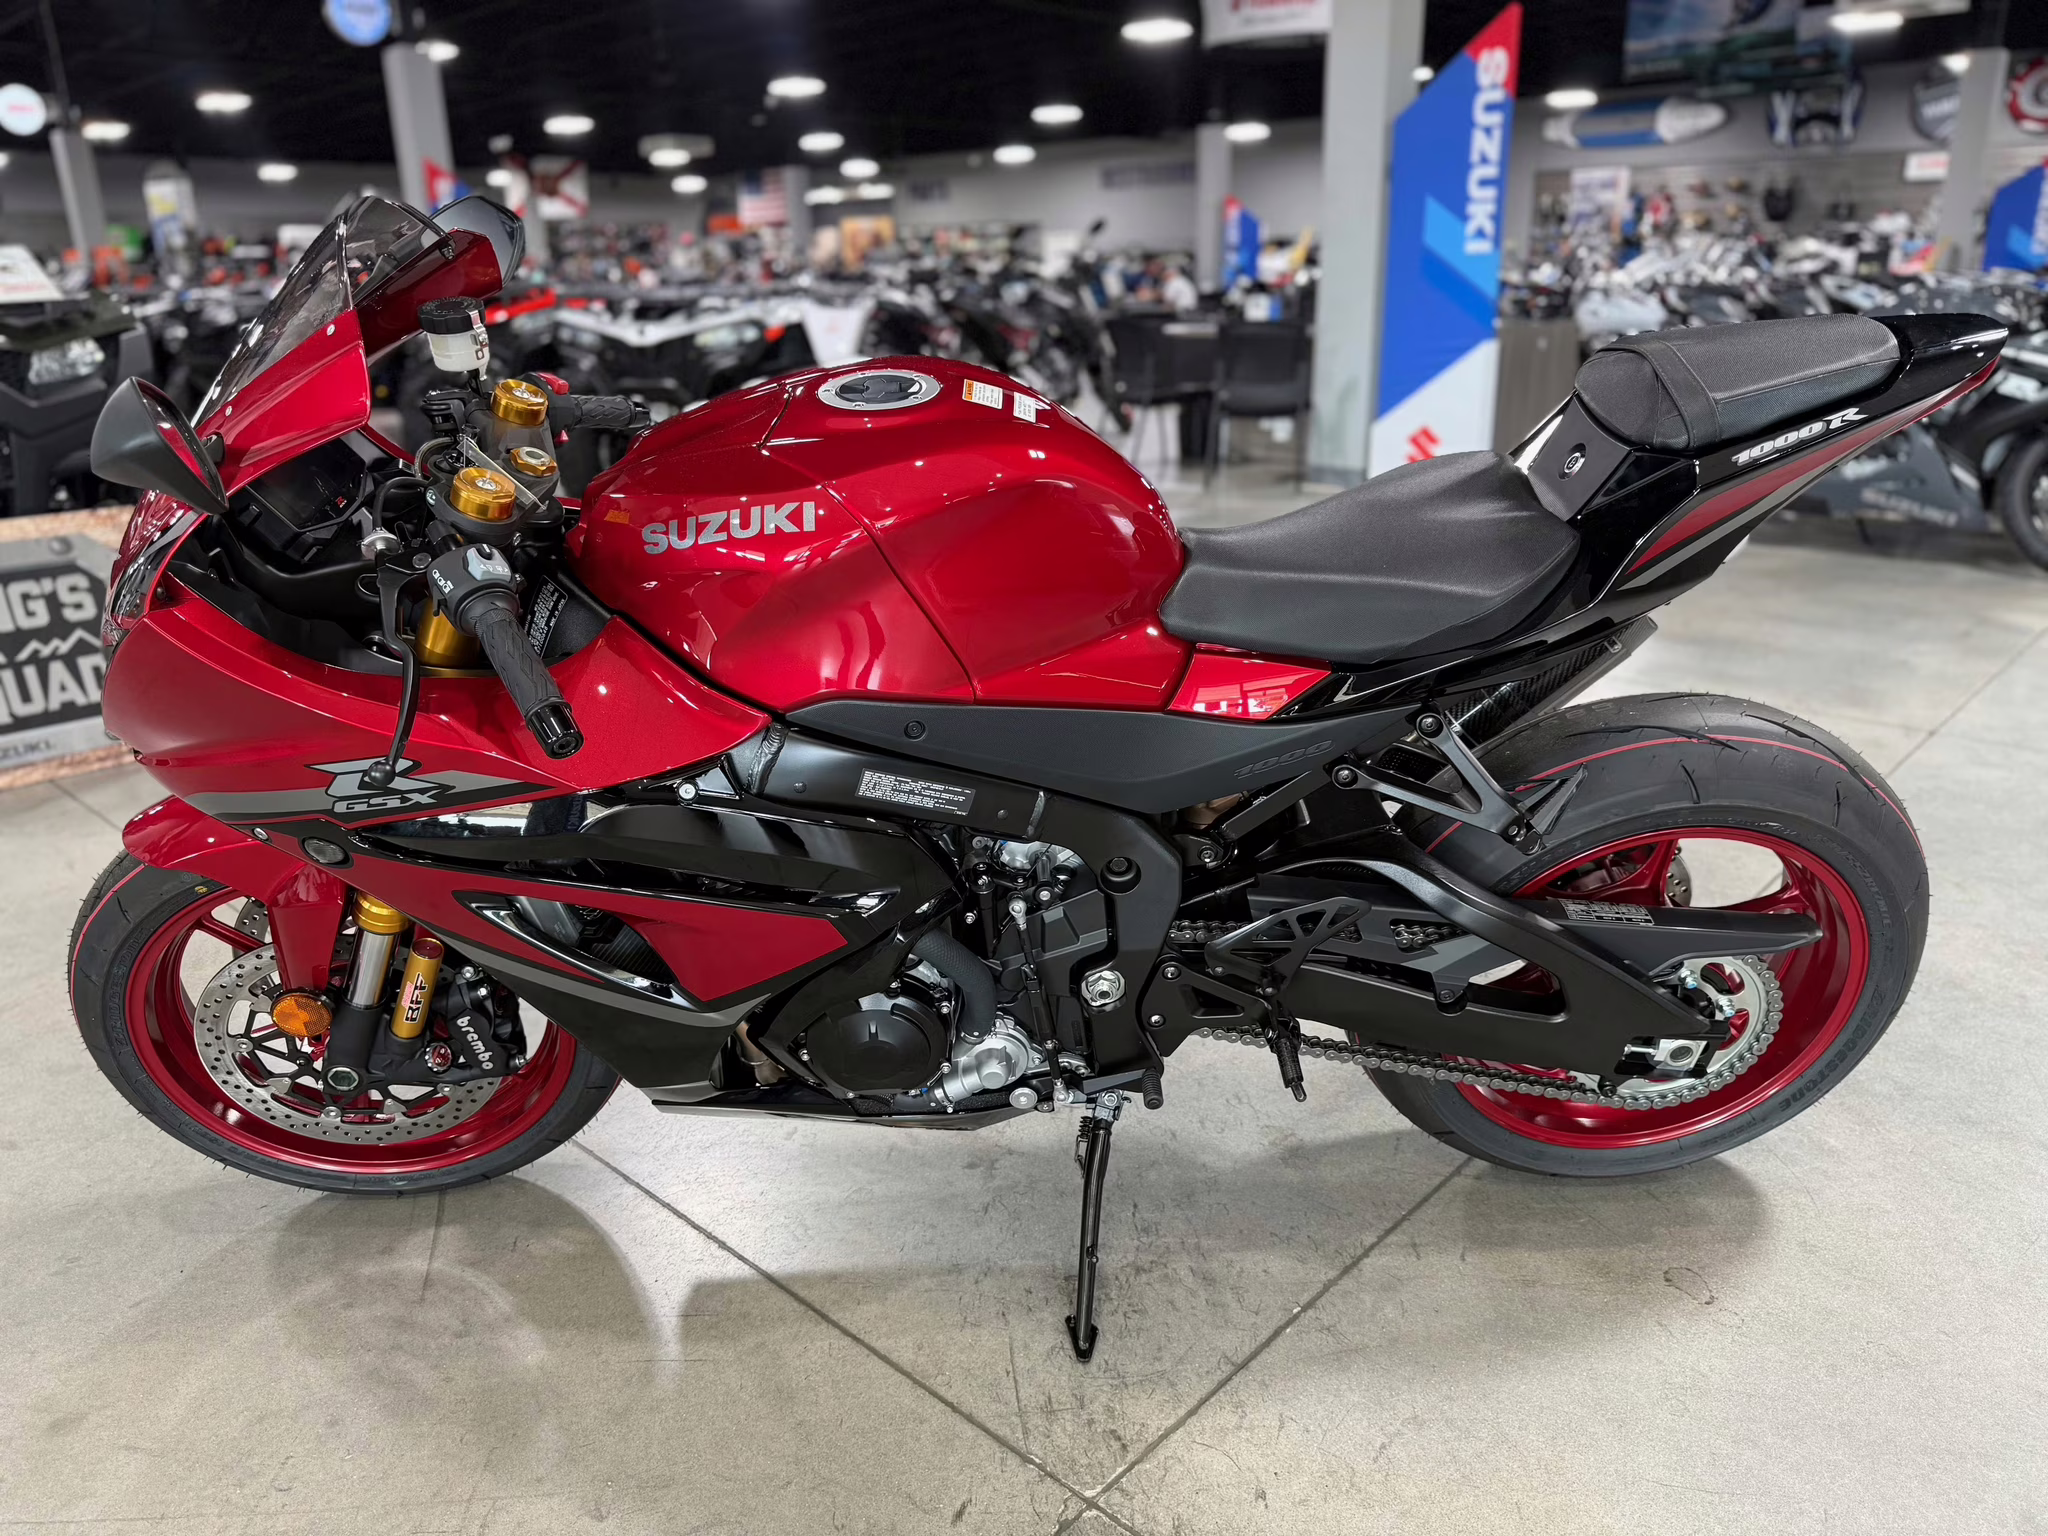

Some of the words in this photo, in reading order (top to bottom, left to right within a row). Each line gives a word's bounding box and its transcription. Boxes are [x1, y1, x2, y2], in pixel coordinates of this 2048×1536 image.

[1463, 46, 1511, 255] SUZUKI
[1731, 421, 1827, 467] 1000
[641, 501, 816, 555] SUZUKI
[1233, 740, 1336, 780] 1000
[333, 789, 443, 814] GSX
[404, 972, 429, 1023] BFF
[456, 1016, 494, 1070] brembo
[1778, 983, 1887, 1113] BRIDGESTONE
